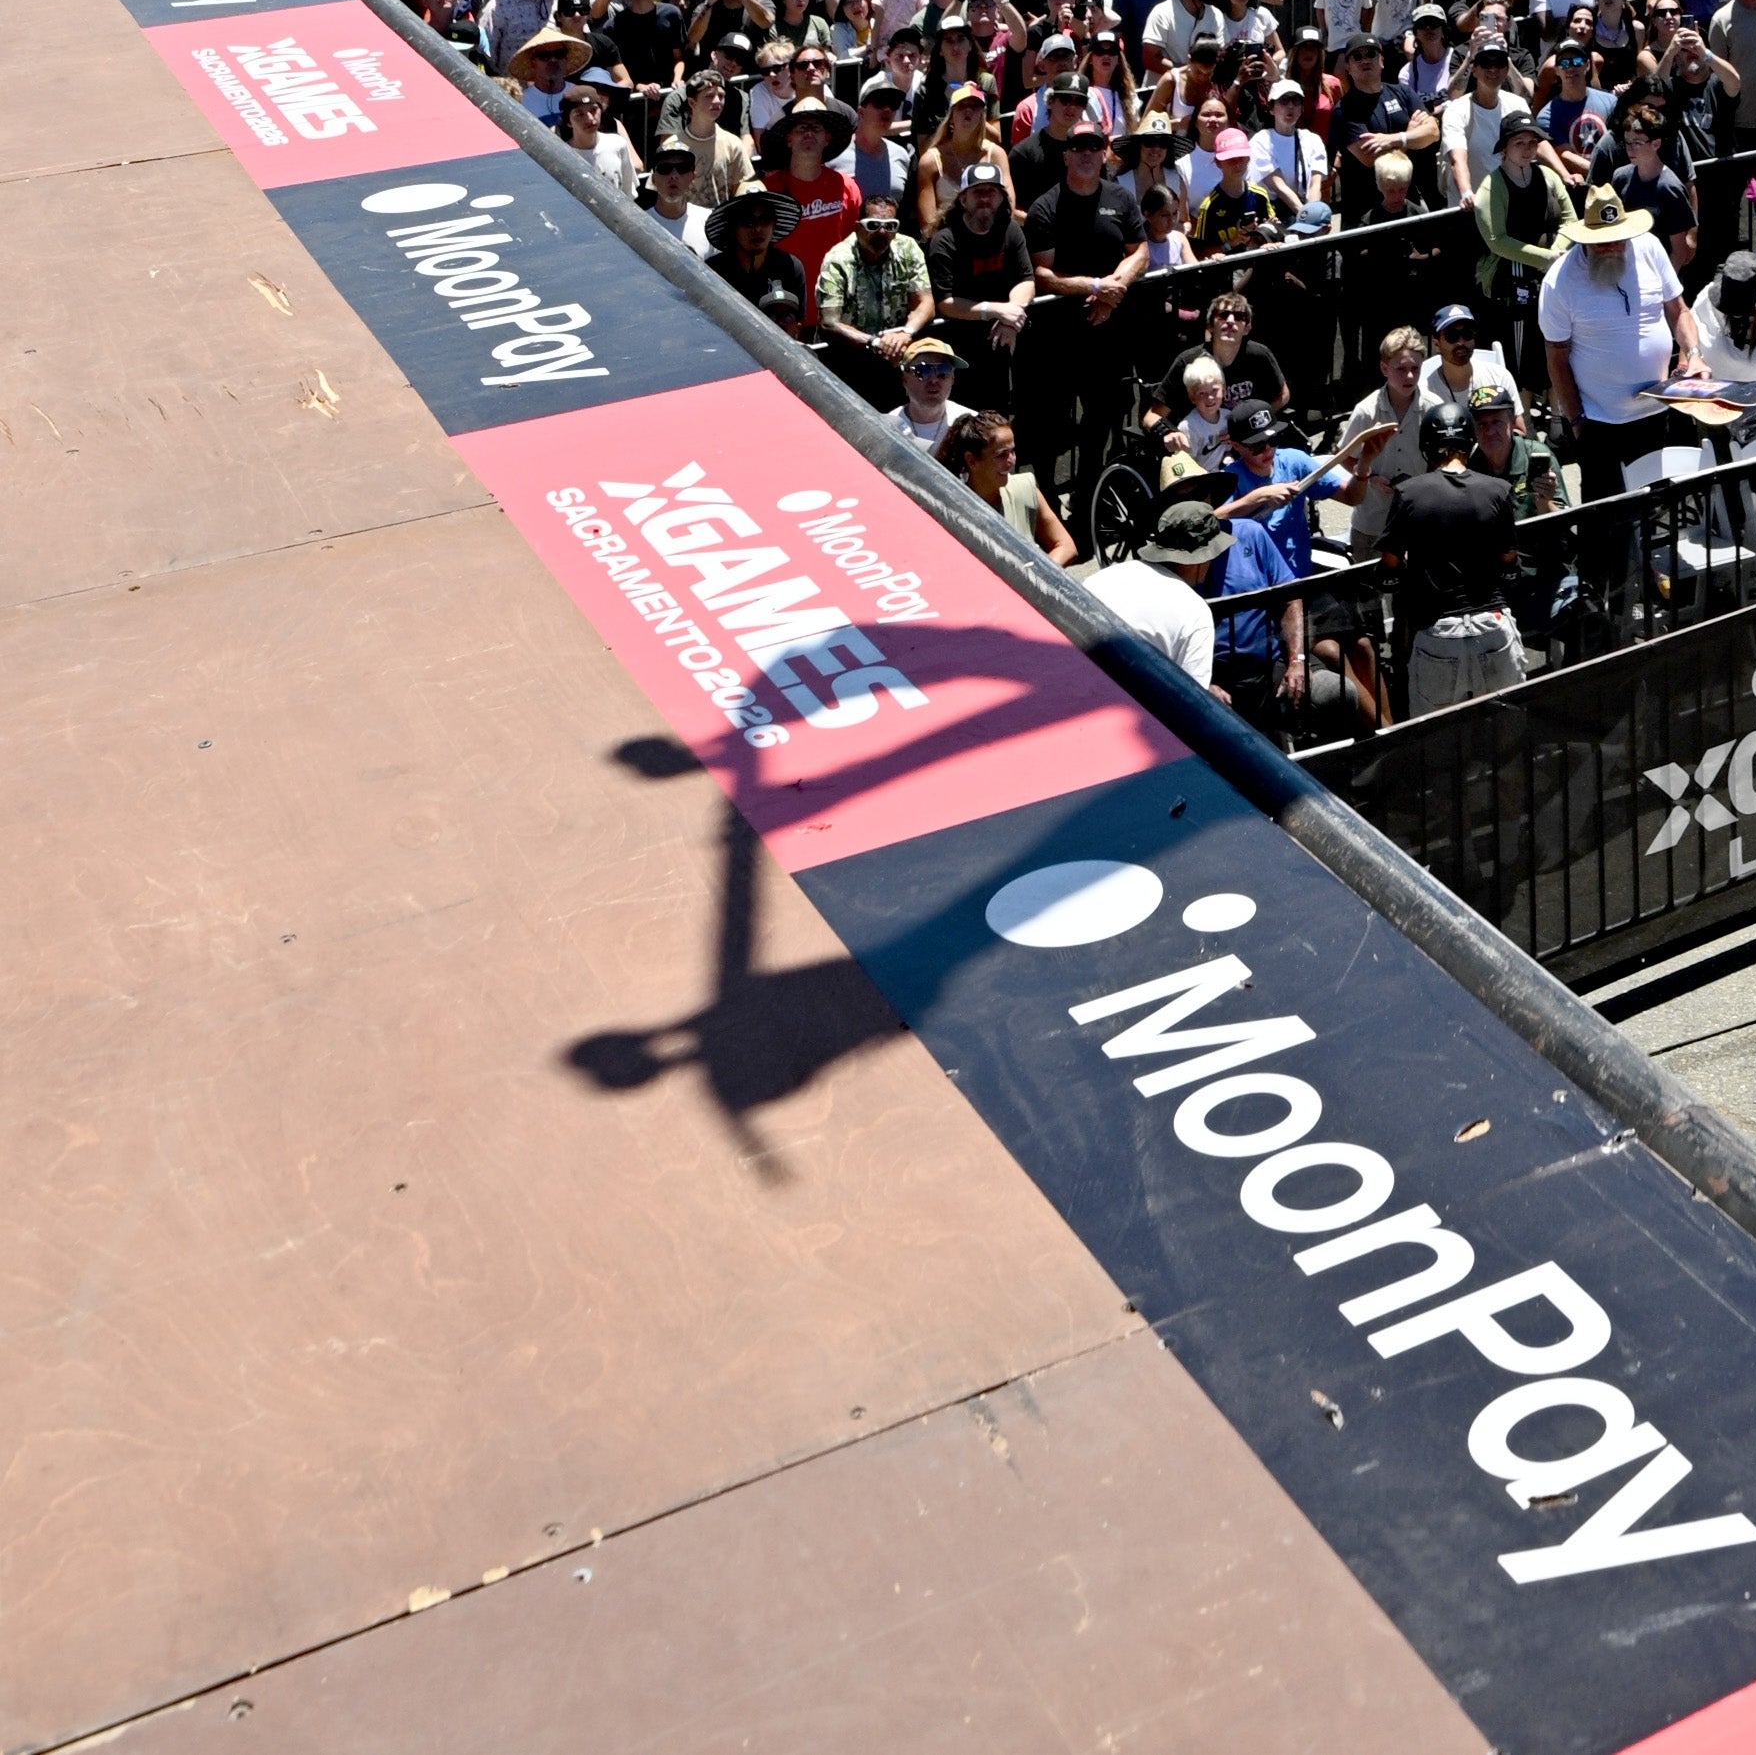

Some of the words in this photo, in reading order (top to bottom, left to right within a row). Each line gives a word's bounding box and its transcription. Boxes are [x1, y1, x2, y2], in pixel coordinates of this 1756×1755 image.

[339, 57, 406, 102] MoonPay
[386, 214, 610, 386] MoonPay
[797, 511, 940, 625] MoonPay
